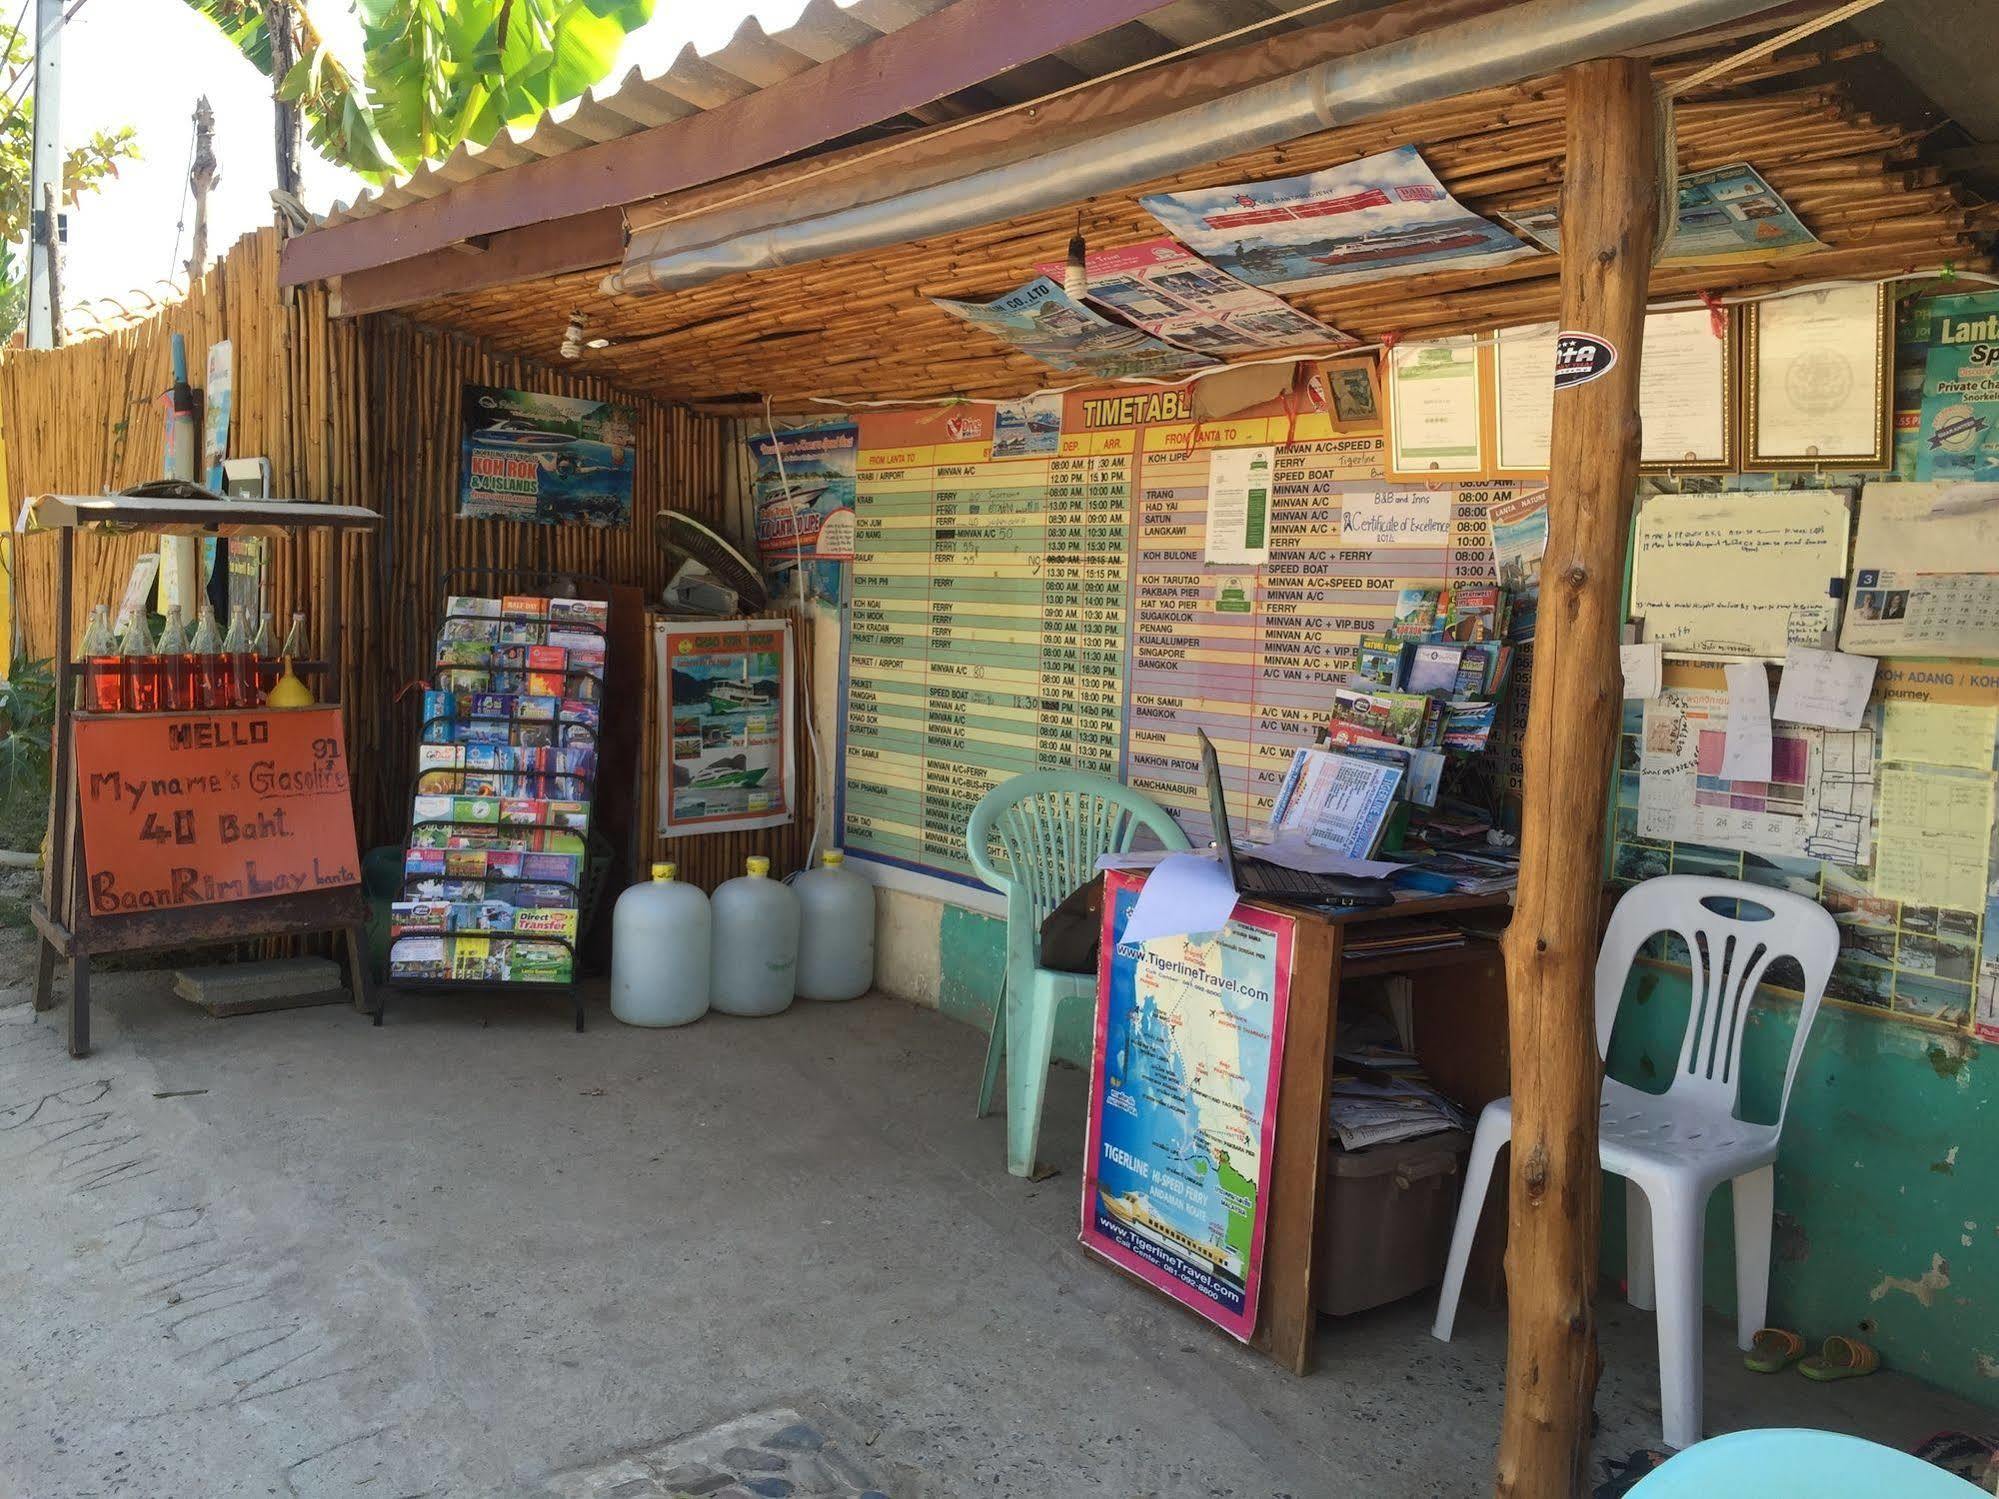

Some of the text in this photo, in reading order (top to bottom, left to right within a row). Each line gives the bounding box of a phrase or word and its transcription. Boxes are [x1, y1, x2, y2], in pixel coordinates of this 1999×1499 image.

[1939, 381, 1977, 393] Private
[1083, 391, 1192, 427] TIMETABL
[1223, 429, 1237, 440] TO
[1063, 442, 1080, 452] DEP.
[1104, 439, 1121, 450] ARR.
[1275, 444, 1310, 455] MINVAN
[869, 454, 916, 464] FROM LANTA TO
[1148, 454, 1166, 463] KOH
[1274, 458, 1305, 468] FERRY
[472, 457, 504, 477] KOH
[937, 466, 976, 476] MINVAN A/C
[857, 472, 876, 481] KRABI
[1274, 470, 1335, 481] SPEED BOAT
[491, 479, 537, 492] ISLANDS
[1109, 485, 1124, 494] AM.
[1273, 483, 1330, 494] MINVAN A/C
[936, 492, 957, 501] FERRY
[1147, 490, 1174, 499] TRANG
[1459, 492, 1488, 501] 08:00
[1146, 502, 1178, 511] HAD YAI
[1272, 497, 1329, 507] MINVAN A/C
[1458, 507, 1487, 517] 08:00
[936, 517, 955, 526] FERRY
[1108, 514, 1123, 524] AM.
[1145, 515, 1171, 524] SATUN
[1144, 526, 1187, 536] LANGKAWI
[1457, 522, 1486, 531] 08:00
[1270, 538, 1301, 547] FERRY
[1457, 537, 1485, 546] 10:00
[1107, 542, 1122, 552] PM.
[935, 554, 954, 563] FERRY
[1143, 551, 1197, 560] KOH BULONE
[1270, 551, 1372, 561] MINVAN A/C FERRY
[1106, 569, 1120, 579] PM.
[1269, 565, 1328, 574] SPEED BOAT
[1455, 567, 1484, 576] 13:00
[1142, 576, 1200, 585] KOH TARUTAO
[1367, 579, 1394, 589] BOAT
[1863, 575, 1872, 584] 3
[1181, 589, 1200, 597] PIER
[1141, 600, 1156, 608] HAT
[1178, 601, 1197, 609] PIER
[1266, 604, 1297, 614] FERRY
[1104, 612, 1120, 621] AM.
[1140, 612, 1193, 622] SUGAIKOLOK
[1140, 624, 1173, 633] PENANG
[1265, 630, 1322, 641] MINVAN A/C
[1139, 636, 1200, 646] KUALALUMPER
[1138, 648, 1185, 658] SINGAPORE
[930, 664, 954, 674] MINVAN
[1138, 660, 1178, 671] BANGKOK
[1263, 669, 1347, 683] A/C VAN PLANE
[1908, 672, 1953, 685] ADANG
[1971, 676, 1999, 688] KOH
[929, 688, 968, 699] SPEED BOAT
[1137, 696, 1183, 707] KOH SAMUI
[1136, 708, 1176, 719] BANGKOK
[1135, 731, 1166, 742] HUAHIN
[1134, 755, 1199, 771] NAKHON PATOM
[1133, 779, 1197, 795] KANCHANABURI
[139, 810, 196, 845] 40
[1715, 818, 1728, 828] 24
[1768, 823, 1780, 833] 26
[520, 913, 549, 921] Direct
[519, 920, 566, 930] Transfer
[1117, 945, 1269, 1002] www.TigerlineTravel.com
[1104, 1143, 1149, 1179] TIGERLINE
[1116, 1235, 1132, 1248] Call
[1100, 1217, 1239, 1303] www.TigerlineTravel.com
